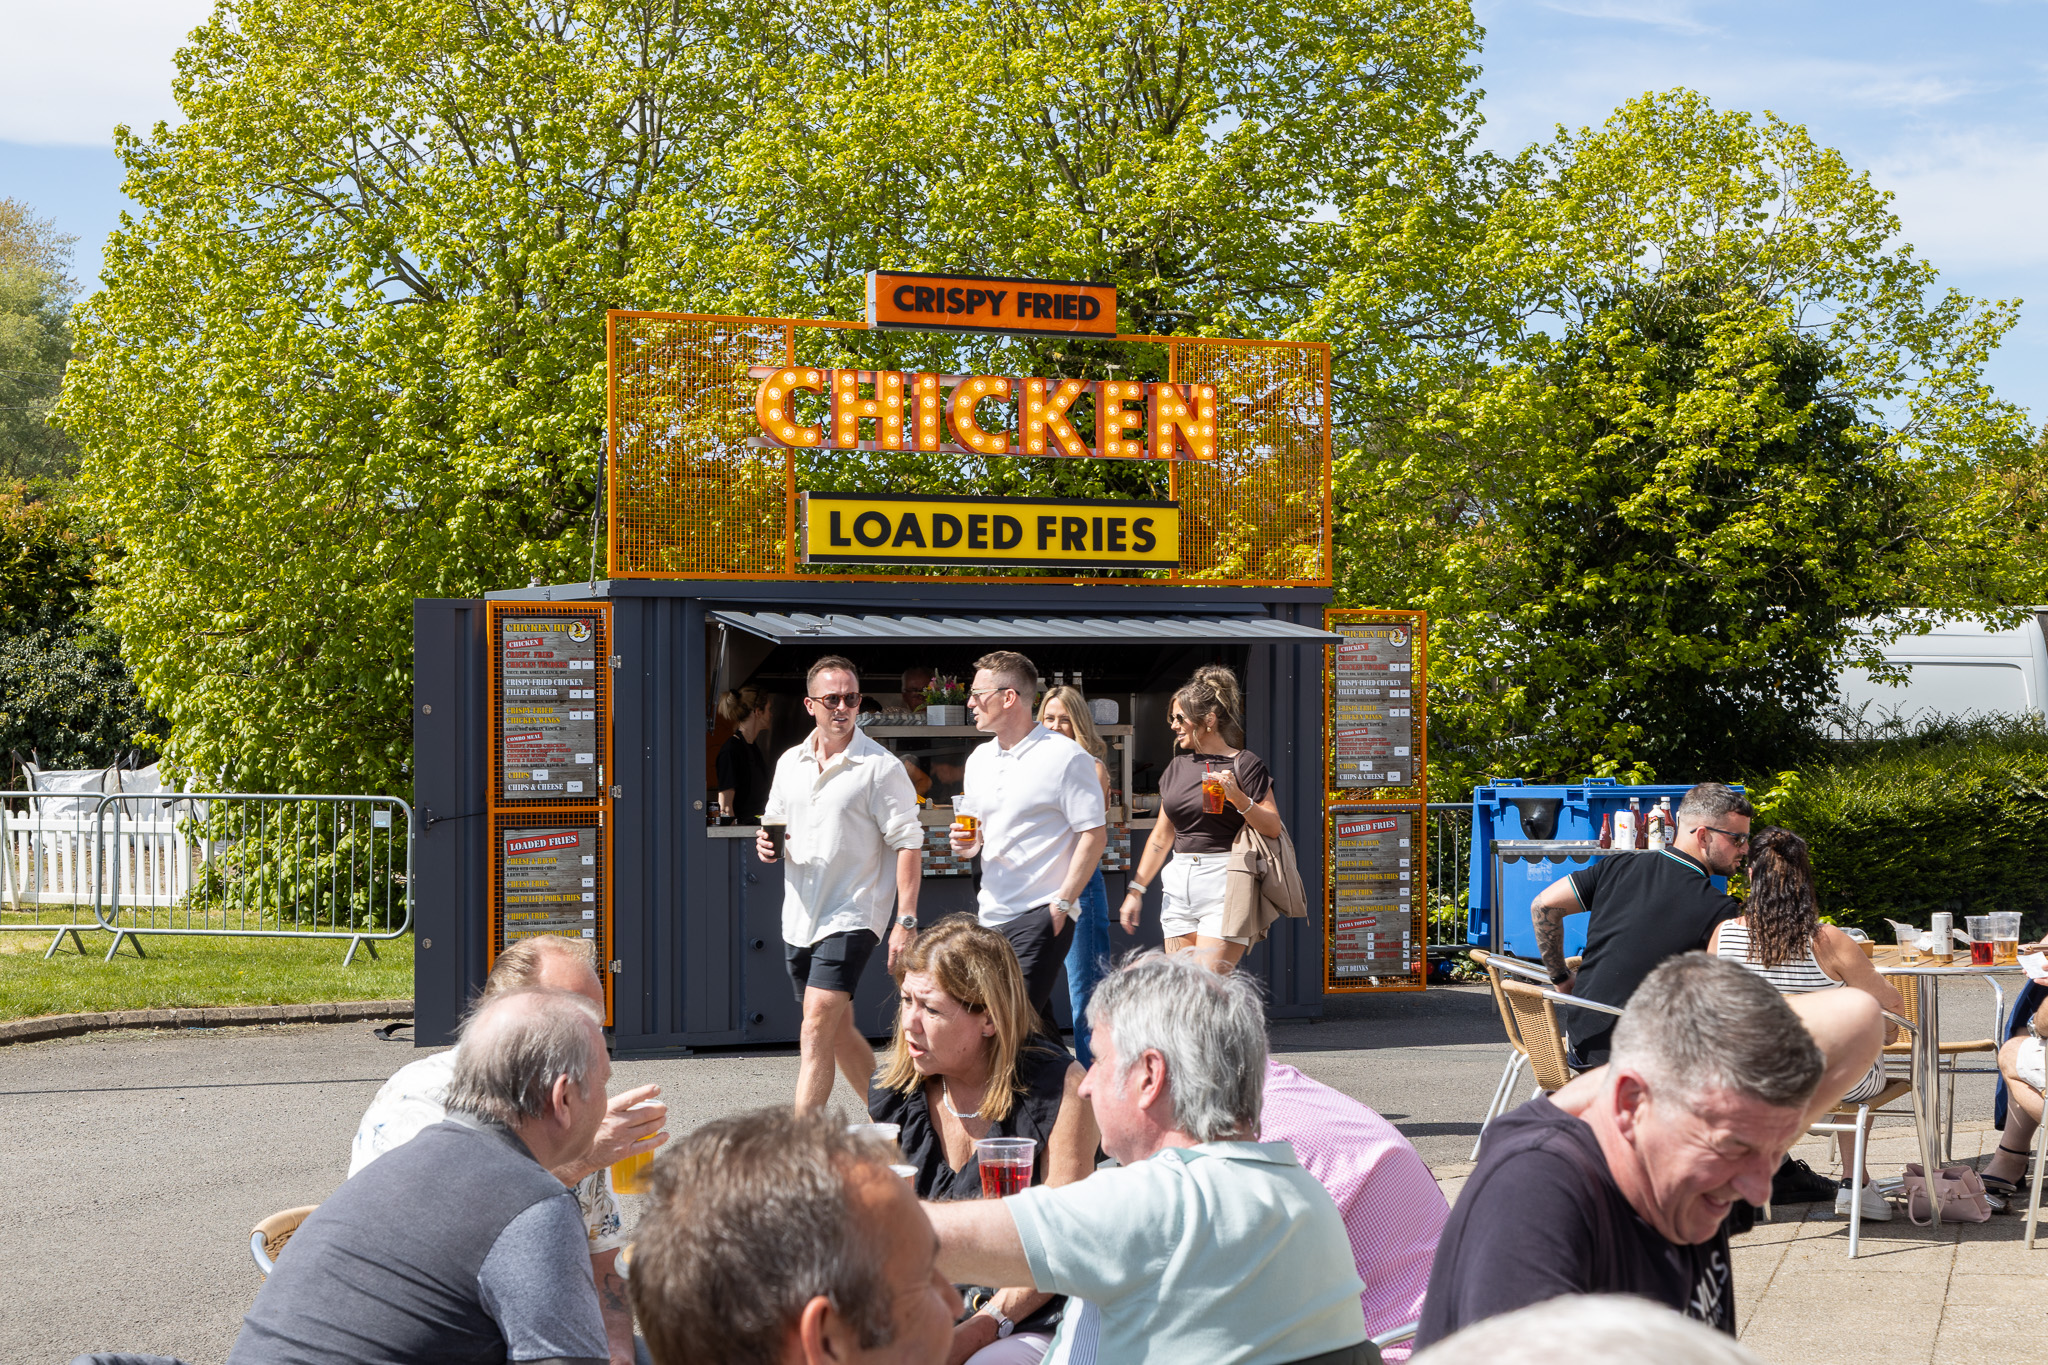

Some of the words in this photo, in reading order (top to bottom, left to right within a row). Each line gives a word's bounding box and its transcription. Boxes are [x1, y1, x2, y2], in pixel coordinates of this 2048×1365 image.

[893, 285, 1007, 316] CRISPY
[1018, 291, 1101, 321] FRIED
[755, 367, 1217, 460] CHICKEN
[829, 510, 1023, 550] LOADED
[1037, 515, 1157, 553] FRIES
[506, 624, 550, 632] CHICKEN
[554, 624, 573, 632] HUT
[509, 639, 538, 648] CHICKEN
[1341, 824, 1370, 834] LOADED
[1372, 820, 1395, 830] FRIES
[510, 840, 546, 852] LOADED
[549, 835, 577, 846] FRIES
